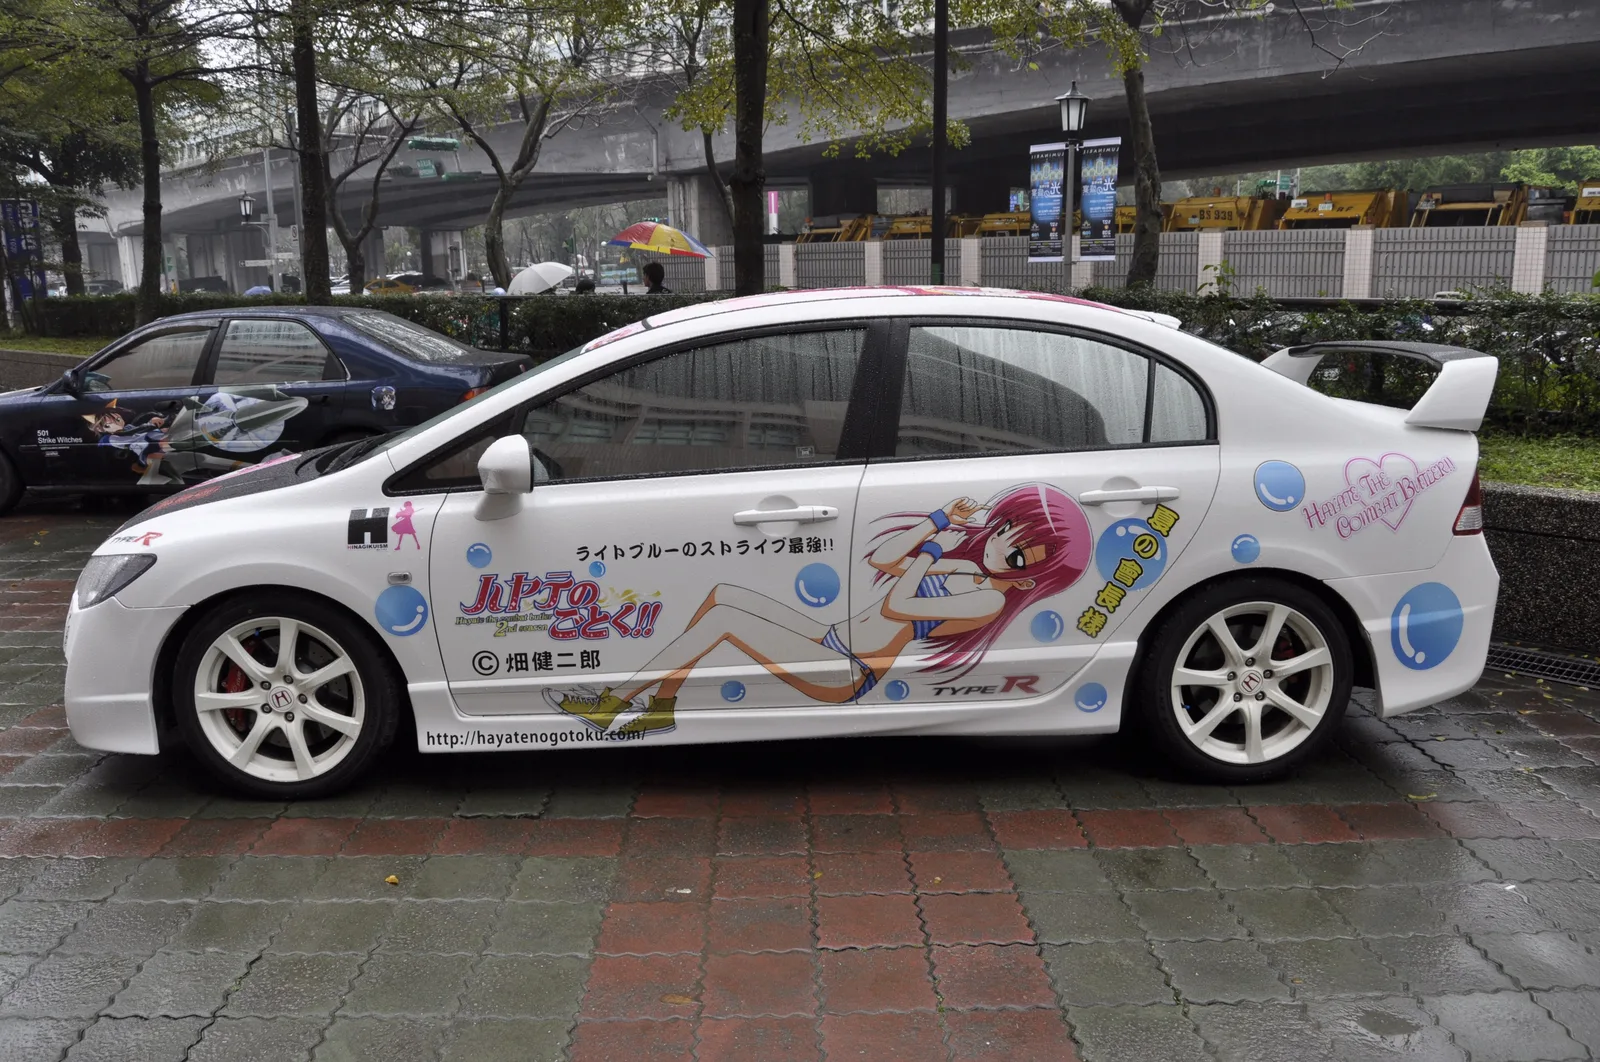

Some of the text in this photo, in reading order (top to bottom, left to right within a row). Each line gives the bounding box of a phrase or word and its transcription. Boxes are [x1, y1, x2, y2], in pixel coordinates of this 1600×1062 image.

[37, 436, 82, 444] Strike Witches
[455, 616, 485, 626] Hayate
[932, 675, 1041, 696] TYPE R
[426, 727, 647, 749] http://hayatenogotoku.com/
